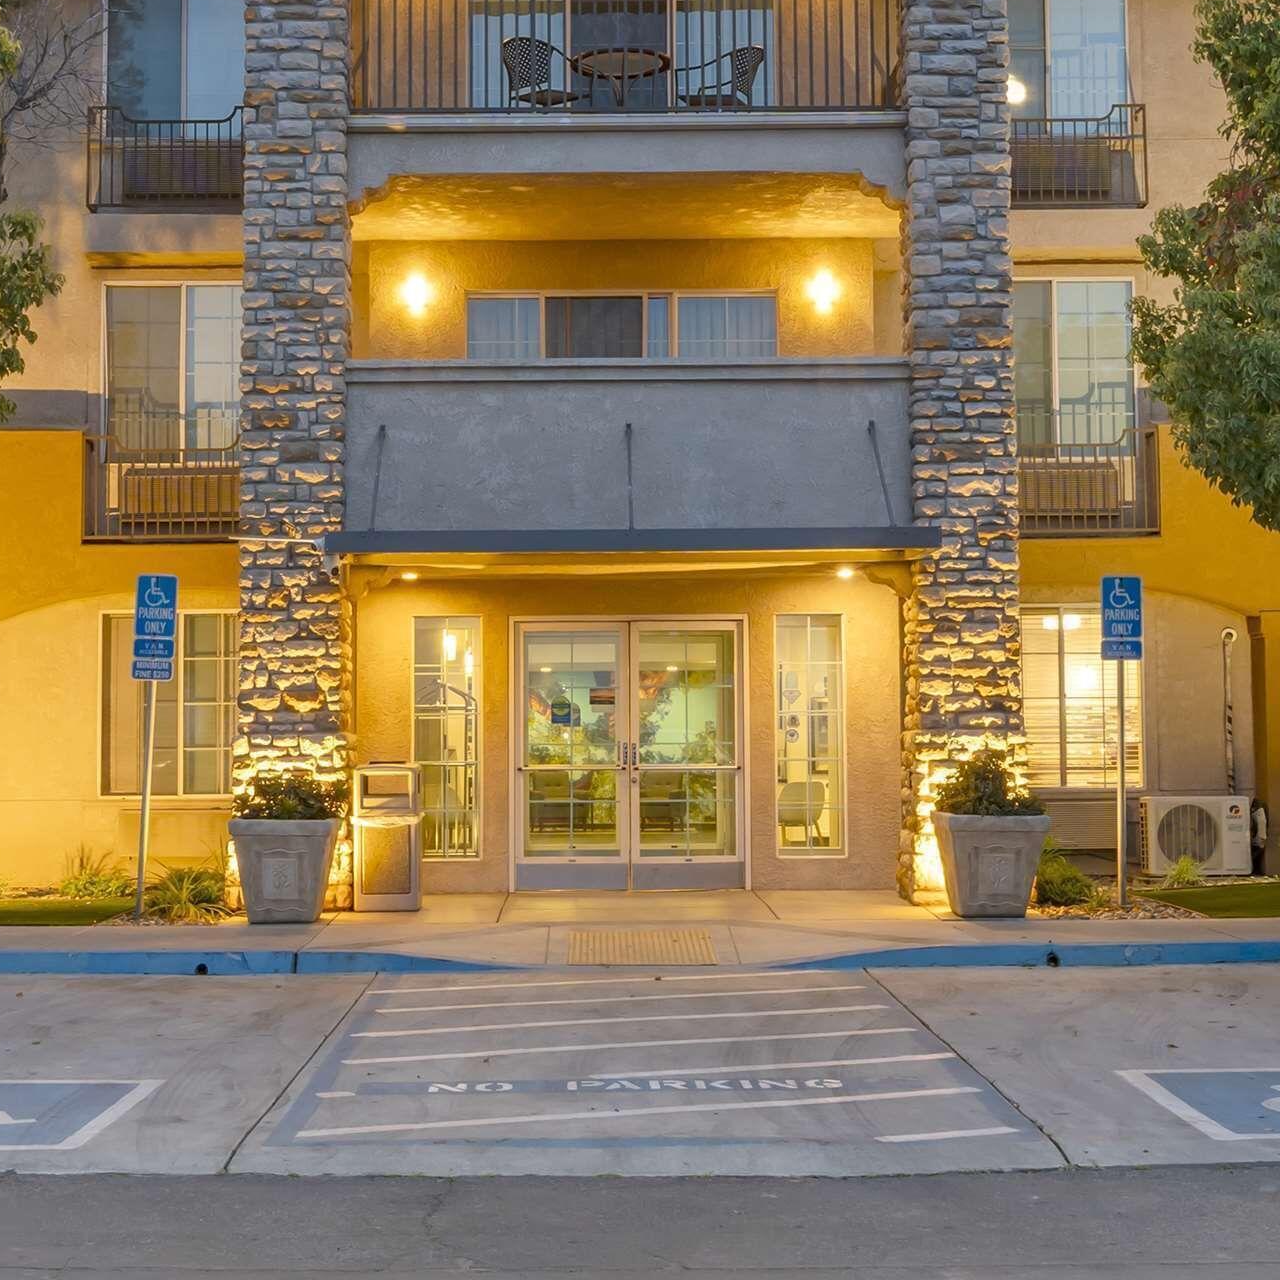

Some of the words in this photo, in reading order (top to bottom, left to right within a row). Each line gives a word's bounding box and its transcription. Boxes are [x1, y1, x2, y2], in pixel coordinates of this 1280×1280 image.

[138, 607, 174, 620] PARKING
[1104, 608, 1140, 621] PARKING
[144, 621, 166, 633] ONLY
[1111, 622, 1133, 635] ONLY
[134, 670, 152, 678] FINE
[427, 1082, 513, 1094] NO
[566, 1078, 844, 1092] PARKING
